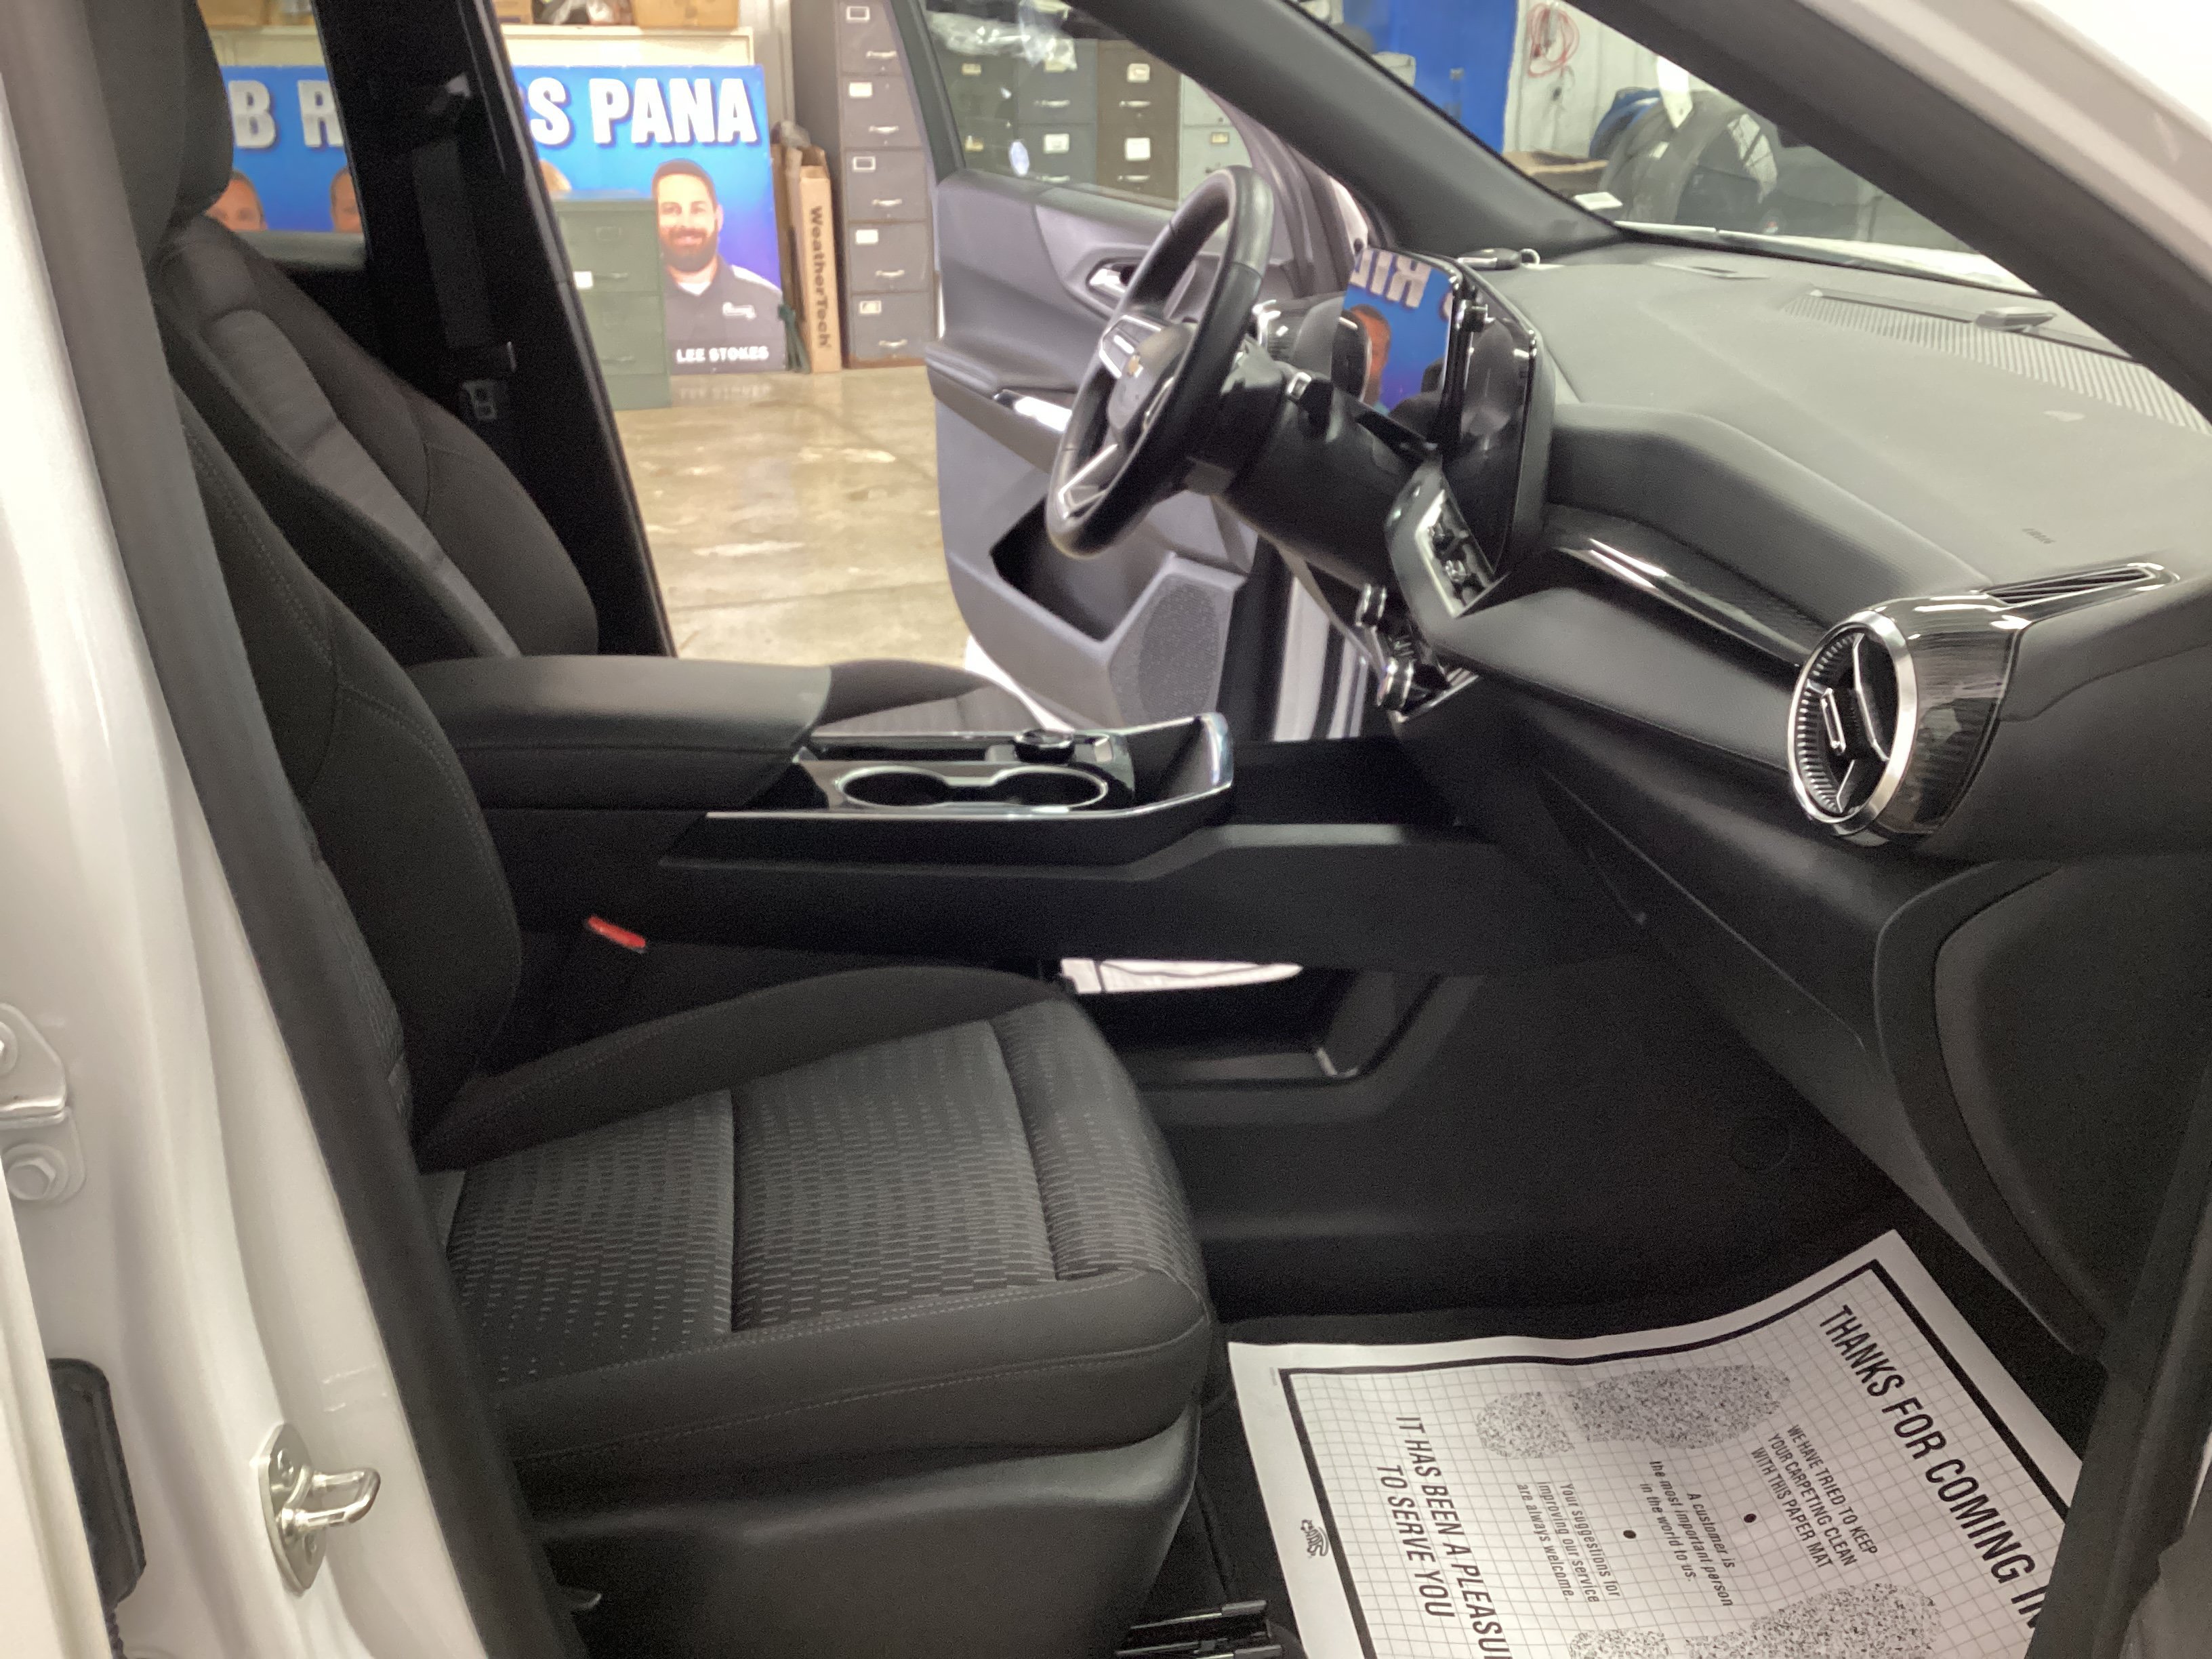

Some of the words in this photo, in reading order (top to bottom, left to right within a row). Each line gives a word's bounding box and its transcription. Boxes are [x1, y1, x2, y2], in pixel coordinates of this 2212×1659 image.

[588, 78, 758, 144] PANA
[676, 348, 705, 363] LEE
[709, 346, 769, 362] STOKES
[1396, 1416, 1426, 1434] IT
[1820, 1304, 1905, 1397] THANKS
[1881, 1397, 1947, 1460] FOR
[1925, 1458, 2035, 1584] COMING
[1376, 1465, 1408, 1489] TO
[1404, 1439, 1441, 1477] HAS
[1421, 1485, 1465, 1536] BEEN
[1640, 1483, 1653, 1493] in
[1646, 1496, 1664, 1514] the
[1751, 1447, 1778, 1476] WITH
[1767, 1473, 1792, 1500] THIS
[1782, 1498, 1816, 1542] PAPER
[1806, 1541, 1834, 1568] MAT
[1767, 1433, 1793, 1463] YOUR
[1785, 1461, 1832, 1526] CARPETING
[1824, 1527, 1858, 1567] CLEAN
[1787, 1425, 1807, 1443] WE
[1797, 1440, 1824, 1469] HAVE
[1815, 1467, 1846, 1506] TRIED
[1838, 1506, 1859, 1525] TO
[1849, 1525, 1878, 1554] KEEP
[1387, 1496, 1436, 1562] SERVE
[1442, 1542, 1472, 1555] A
[1517, 1484, 1533, 1501] are
[1525, 1504, 1551, 1542] always
[1543, 1545, 1574, 1601] welcome.
[1537, 1481, 1570, 1534] improving
[1562, 1538, 1580, 1557] our
[1572, 1560, 1600, 1603] service
[1560, 1483, 1579, 1507] Your
[1572, 1510, 1612, 1578] suggestions
[1603, 1580, 1620, 1597] for
[1650, 1461, 1666, 1477] the
[1659, 1481, 1684, 1506] most
[1674, 1510, 1714, 1562] important
[1700, 1566, 1734, 1607] person
[1656, 1516, 1685, 1547] world
[1674, 1550, 1688, 1561] to
[1693, 1504, 1729, 1555] customer
[1721, 1557, 1736, 1568] is
[1414, 1570, 1456, 1617] YOU
